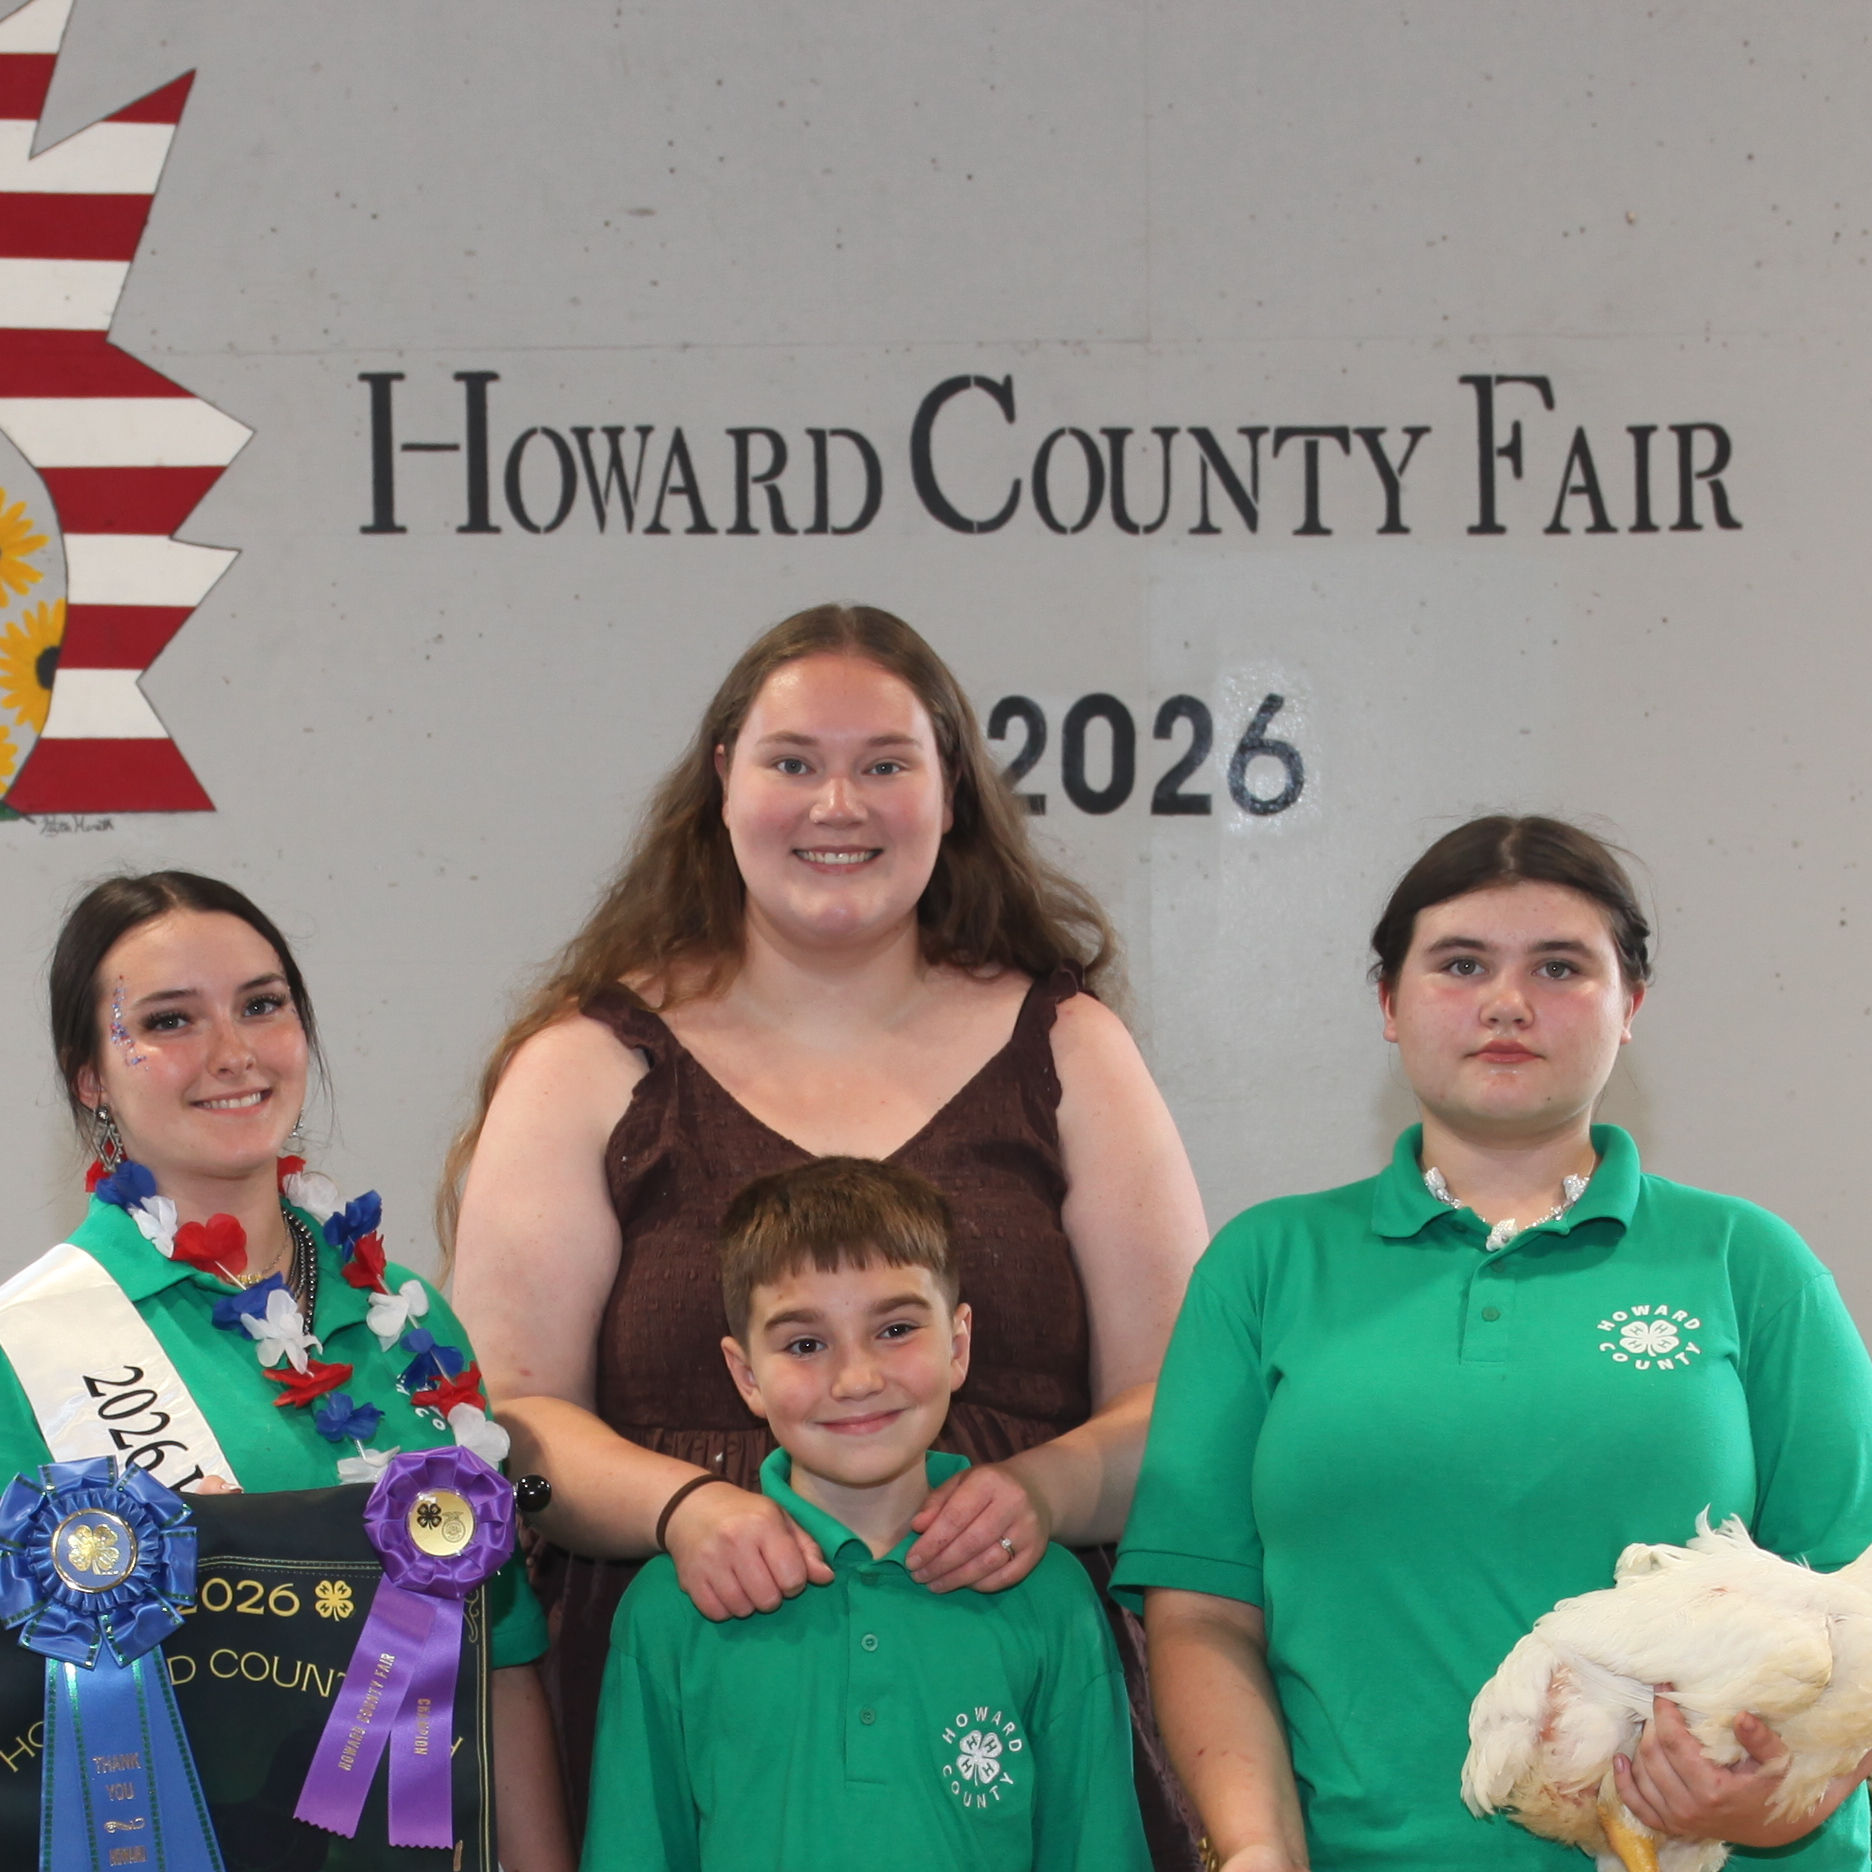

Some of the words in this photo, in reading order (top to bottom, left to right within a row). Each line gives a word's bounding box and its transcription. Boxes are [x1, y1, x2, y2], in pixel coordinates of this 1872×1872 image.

[358, 372, 883, 536] HOWARD
[908, 375, 1431, 536] COUNTY
[1459, 374, 1743, 534] FAIR
[985, 692, 1306, 817] 2026
[1597, 1304, 1701, 1331] HOWARD
[1599, 1342, 1702, 1370] COUNTY
[83, 1365, 188, 1471] 2026
[177, 1577, 300, 1617] 026
[338, 1726, 366, 1772] HOWARD
[357, 1680, 385, 1724] COUNTY
[374, 1652, 396, 1679] FAIR
[414, 1698, 432, 1755] CHAMPION
[942, 1706, 1023, 1752] HOWARD
[92, 1753, 141, 1774] THANK
[943, 1764, 1014, 1808] COUNTY
[106, 1782, 135, 1801] YOU
